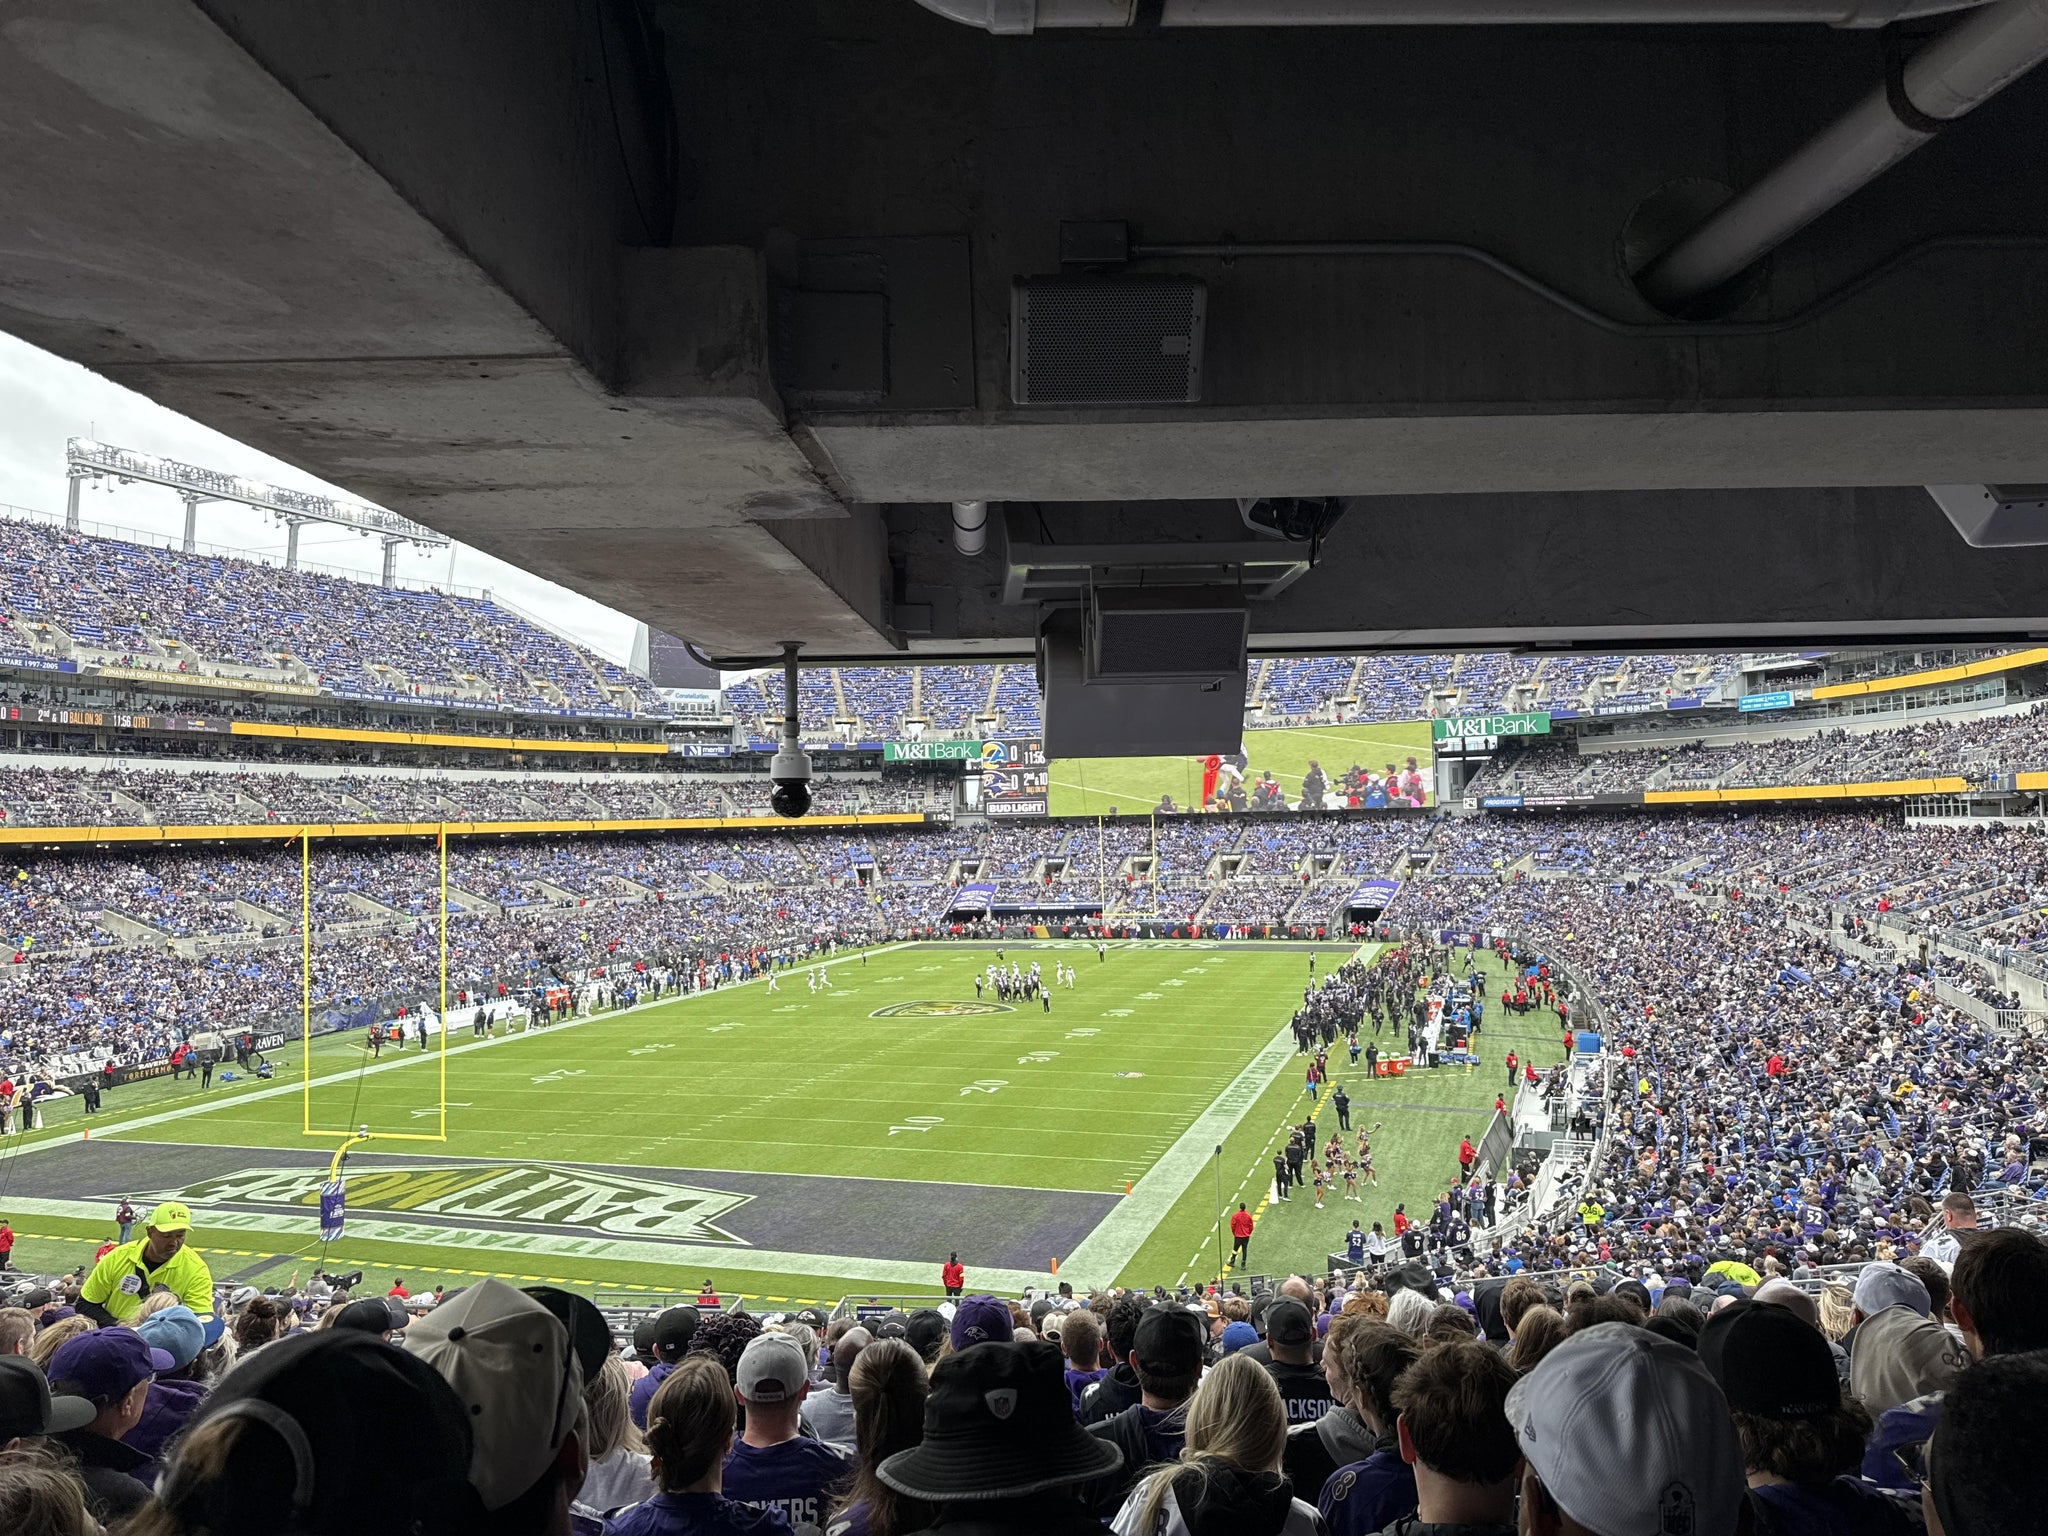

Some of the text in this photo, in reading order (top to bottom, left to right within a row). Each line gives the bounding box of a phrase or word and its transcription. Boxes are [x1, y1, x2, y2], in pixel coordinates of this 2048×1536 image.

[24, 660, 58, 670] 1997-2005
[103, 668, 189, 683] JONATHAN OGDEN 1996-2007
[288, 686, 314, 694] 2002-2012
[1, 706, 6, 719] 0
[38, 709, 50, 722] 2nd
[52, 714, 56, 723] &
[59, 711, 68, 723] 10
[69, 712, 84, 725] BALL
[85, 713, 94, 725] ON
[113, 715, 131, 727] 11:56
[133, 717, 144, 728] QTR
[1444, 715, 1537, 737] M&T Bank
[893, 743, 973, 759] M&T Bank
[1010, 745, 1017, 761] 0
[1024, 751, 1045, 764] 11:56
[1011, 774, 1018, 790] 0
[1024, 772, 1034, 786] 2nd
[1040, 772, 1047, 785] 10
[989, 803, 1043, 812] BUD LIGHT
[1017, 1050, 1060, 1063] 30
[138, 1058, 170, 1070] RAVENS
[1381, 1063, 1388, 1071] G
[1397, 1062, 1403, 1070] G
[531, 1069, 586, 1081] 20
[960, 1080, 1009, 1093] 20
[1209, 1051, 1289, 1117] INTERCEPT CANCER
[889, 1116, 945, 1133] 10
[1475, 1192, 1484, 1201] 52
[1582, 1207, 1598, 1215] 246
[1807, 1210, 1822, 1225] 52
[375, 1226, 538, 1249] TAKES
[1352, 1238, 1361, 1247] 52
[1456, 1231, 1467, 1241] 86
[555, 1242, 617, 1255] IT
[1284, 1399, 1336, 1418] ACKSON
[1332, 1470, 1357, 1502] 8
